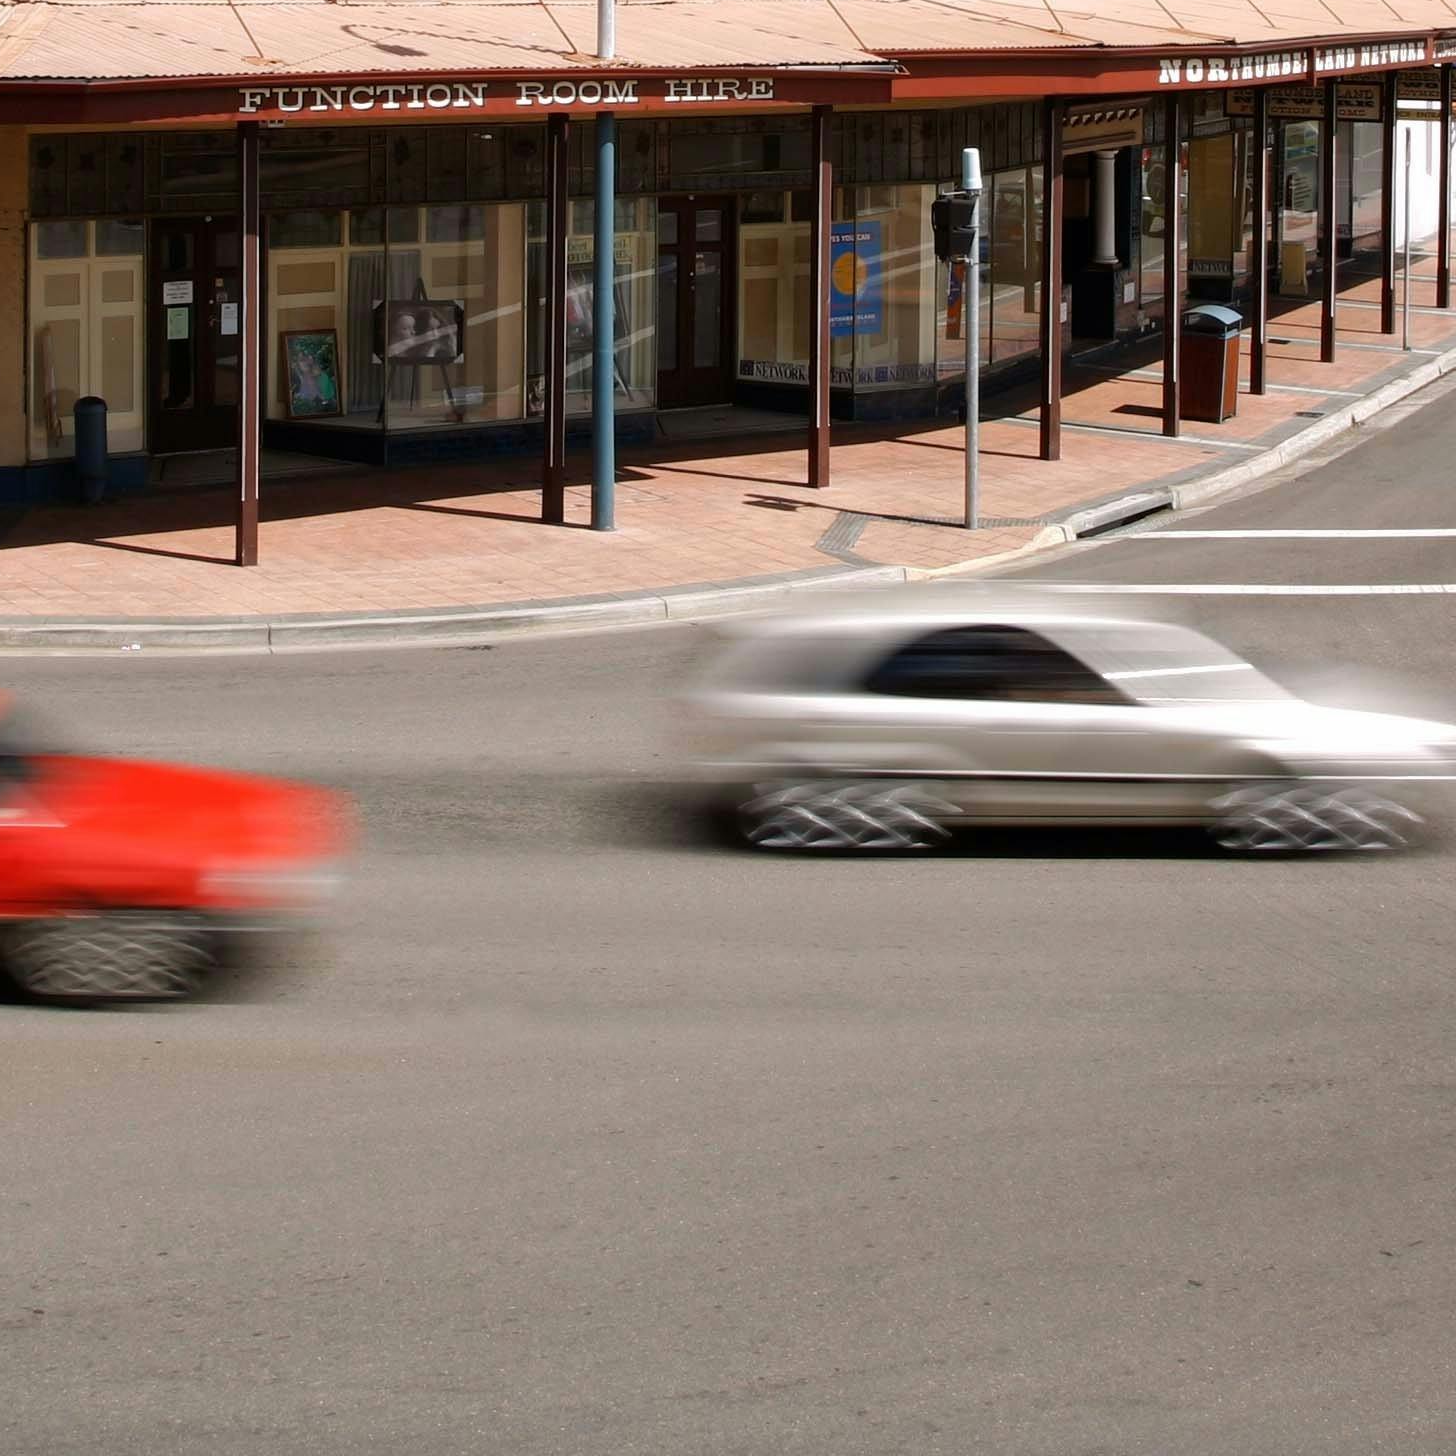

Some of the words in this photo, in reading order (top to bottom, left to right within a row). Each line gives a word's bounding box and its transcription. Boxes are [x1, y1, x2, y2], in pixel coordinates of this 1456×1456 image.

[1158, 47, 1356, 84] NORTHUMBELAND
[1360, 41, 1425, 67] NETWORK
[238, 82, 488, 113] FUNCTION
[515, 80, 639, 106] ROOM
[663, 77, 774, 103] HIRE
[754, 362, 806, 382] NETWORK
[830, 366, 875, 384] ETWORK
